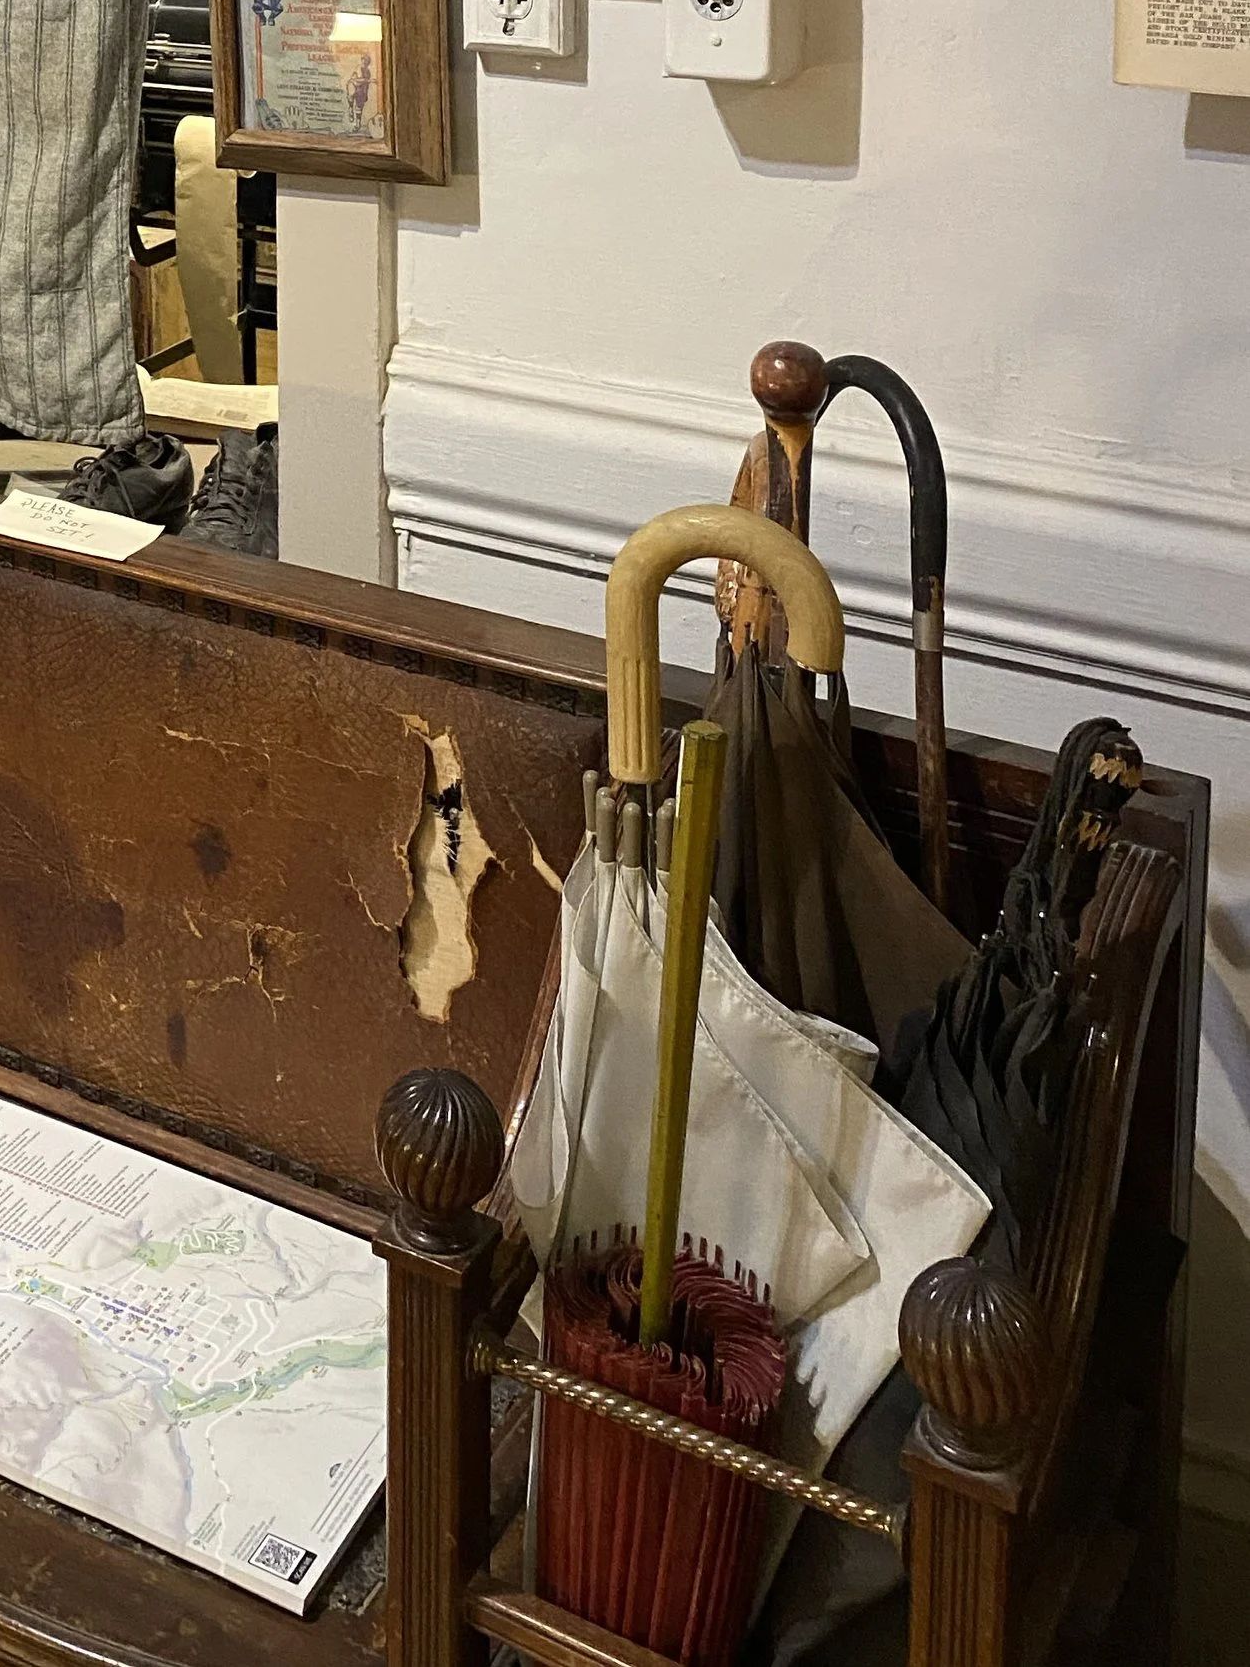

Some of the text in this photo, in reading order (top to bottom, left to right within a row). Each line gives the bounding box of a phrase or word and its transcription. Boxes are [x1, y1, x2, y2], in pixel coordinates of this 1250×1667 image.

[21, 498, 75, 518] PLEASE
[30, 512, 91, 529] DO NOT
